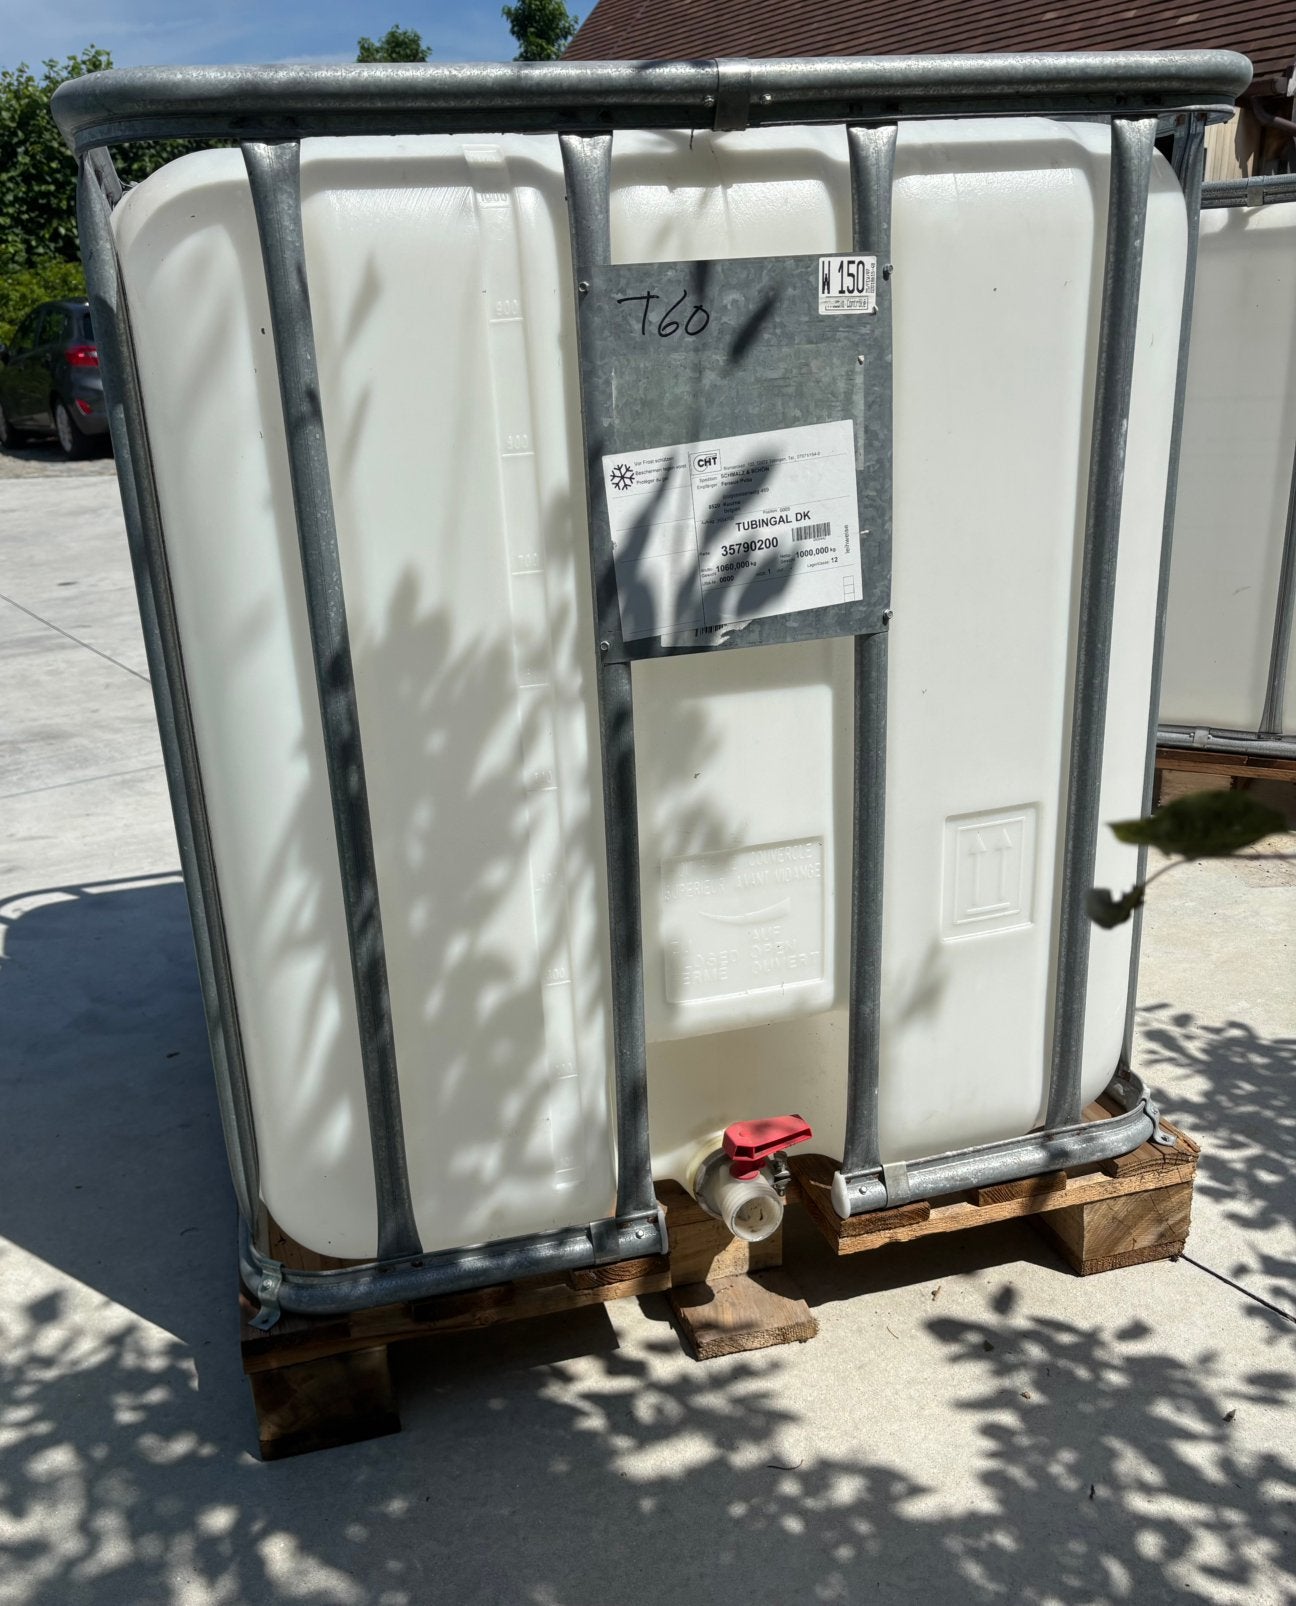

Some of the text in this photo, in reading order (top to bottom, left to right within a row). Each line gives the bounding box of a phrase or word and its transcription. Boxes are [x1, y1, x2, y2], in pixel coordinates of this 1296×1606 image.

[822, 260, 831, 294] W
[838, 260, 865, 294] 150
[617, 289, 710, 338] T60
[697, 456, 718, 468] CHT
[721, 470, 745, 479] SCHMALZ
[735, 514, 792, 532] TUBINGAL
[795, 510, 811, 522] DK
[721, 536, 779, 557] 35790200
[796, 546, 829, 559] 1000,000
[716, 561, 750, 573] 1060,000
